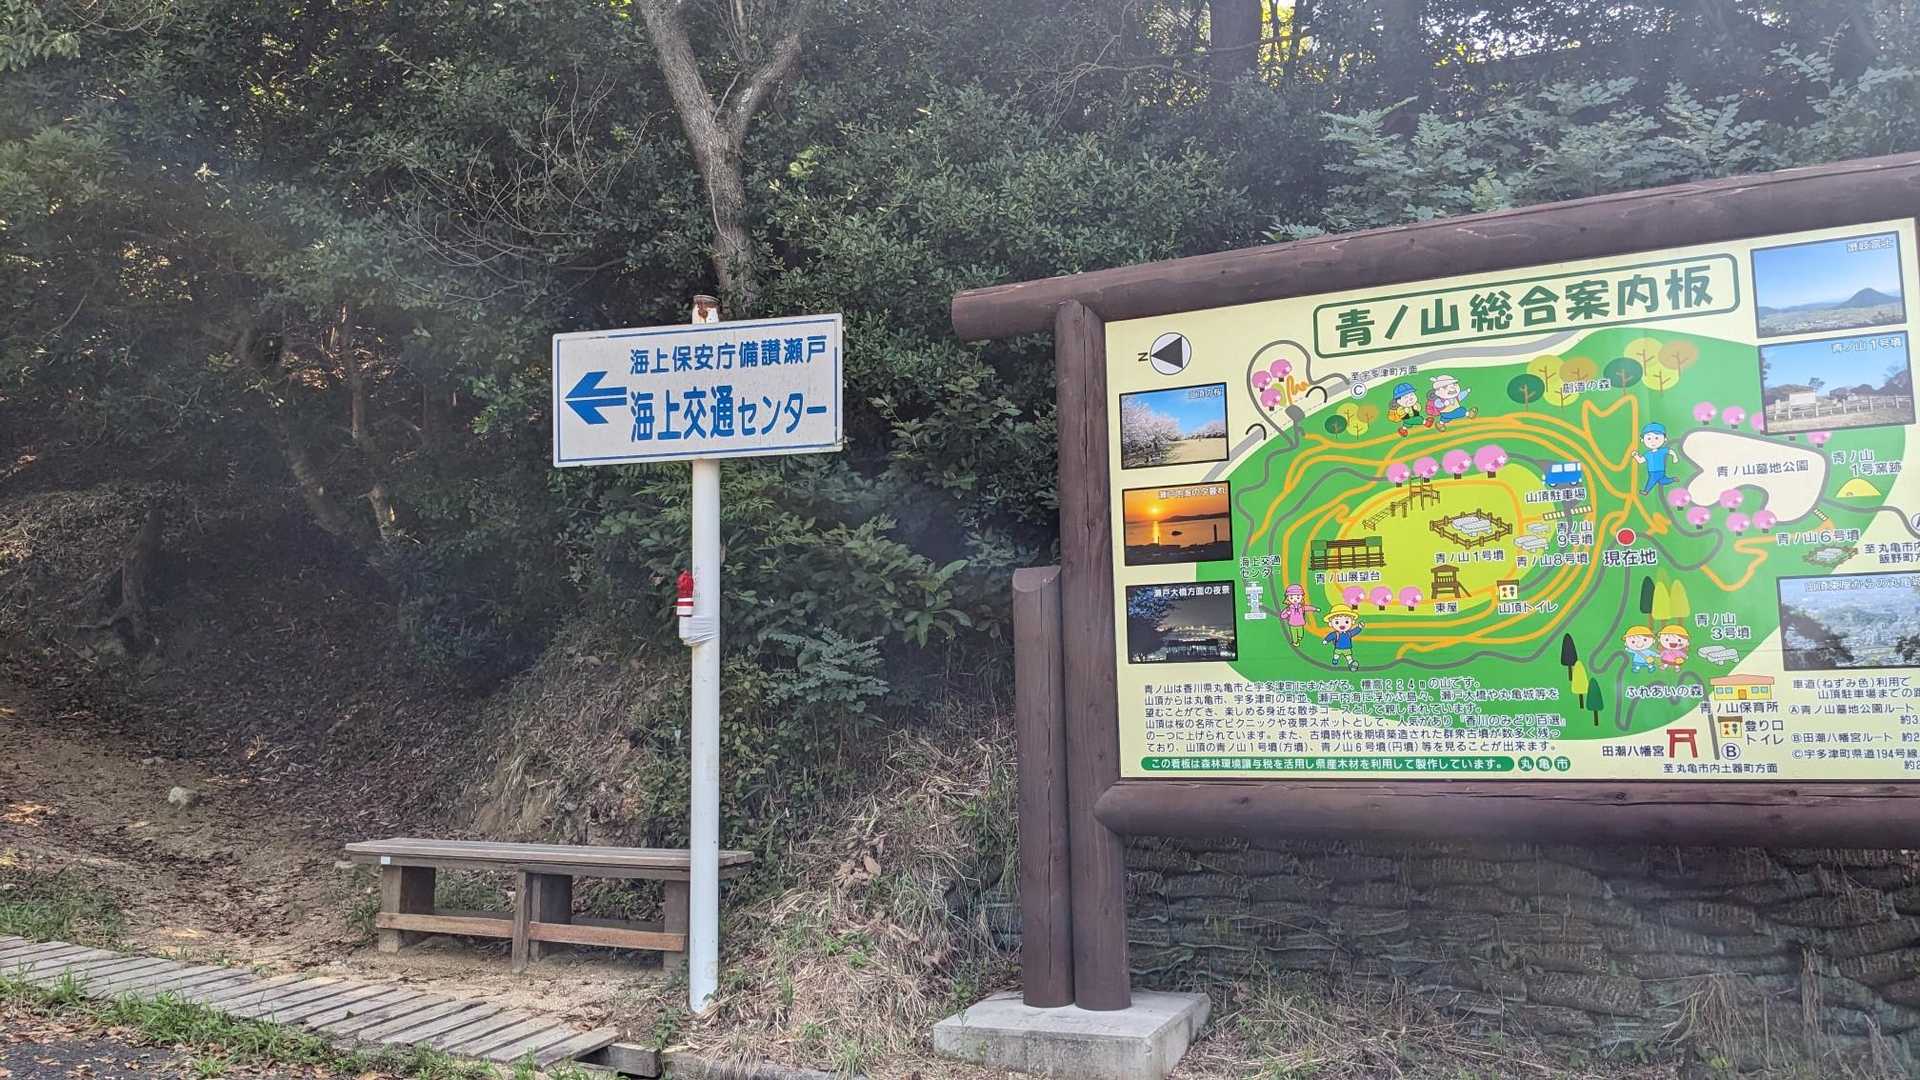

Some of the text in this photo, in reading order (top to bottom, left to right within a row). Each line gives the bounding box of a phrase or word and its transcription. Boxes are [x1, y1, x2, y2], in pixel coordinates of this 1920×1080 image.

[1335, 265, 1713, 348] 青ノ山総合案内板
[630, 335, 827, 375] 海上保安庁備讃瀬戸
[1137, 351, 1148, 362] N
[630, 385, 827, 442] 海上交通センター
[1832, 449, 1873, 463] 青ノ山
[1716, 460, 1809, 477] 青ノ山墓地公園
[1526, 488, 1586, 503] 山頂駐車場
[1557, 521, 1593, 533] 青ノ山
[1558, 533, 1593, 546] 9号墳
[1777, 529, 1860, 545] 青ノ山6号墳
[1241, 555, 1281, 567] 海上交通
[1435, 550, 1504, 563] 青ノ山1号墳
[1516, 552, 1589, 567] 青ノ山8号墳
[1604, 549, 1656, 566] 現在地
[1241, 567, 1281, 578] センター
[1315, 571, 1380, 584] 青ノ山展望台
[1153, 585, 1231, 599] 瀬戸大橋方面の夜景
[1435, 602, 1458, 614] 東屋
[1498, 601, 1558, 614] 山頂トイレ
[1695, 612, 1736, 625] 青ノ山
[1711, 626, 1750, 639] 3号墳
[1626, 684, 1703, 698] ふれあいの森
[1700, 702, 1778, 714] 青ノ山保育所
[1745, 720, 1784, 732] 登り口
[1745, 733, 1784, 745] トイレ
[1602, 745, 1665, 757] 田潮八幡宮
[1521, 758, 1568, 769] 丸亀市
[1664, 763, 1778, 774] 至丸亀市内土器町方面
